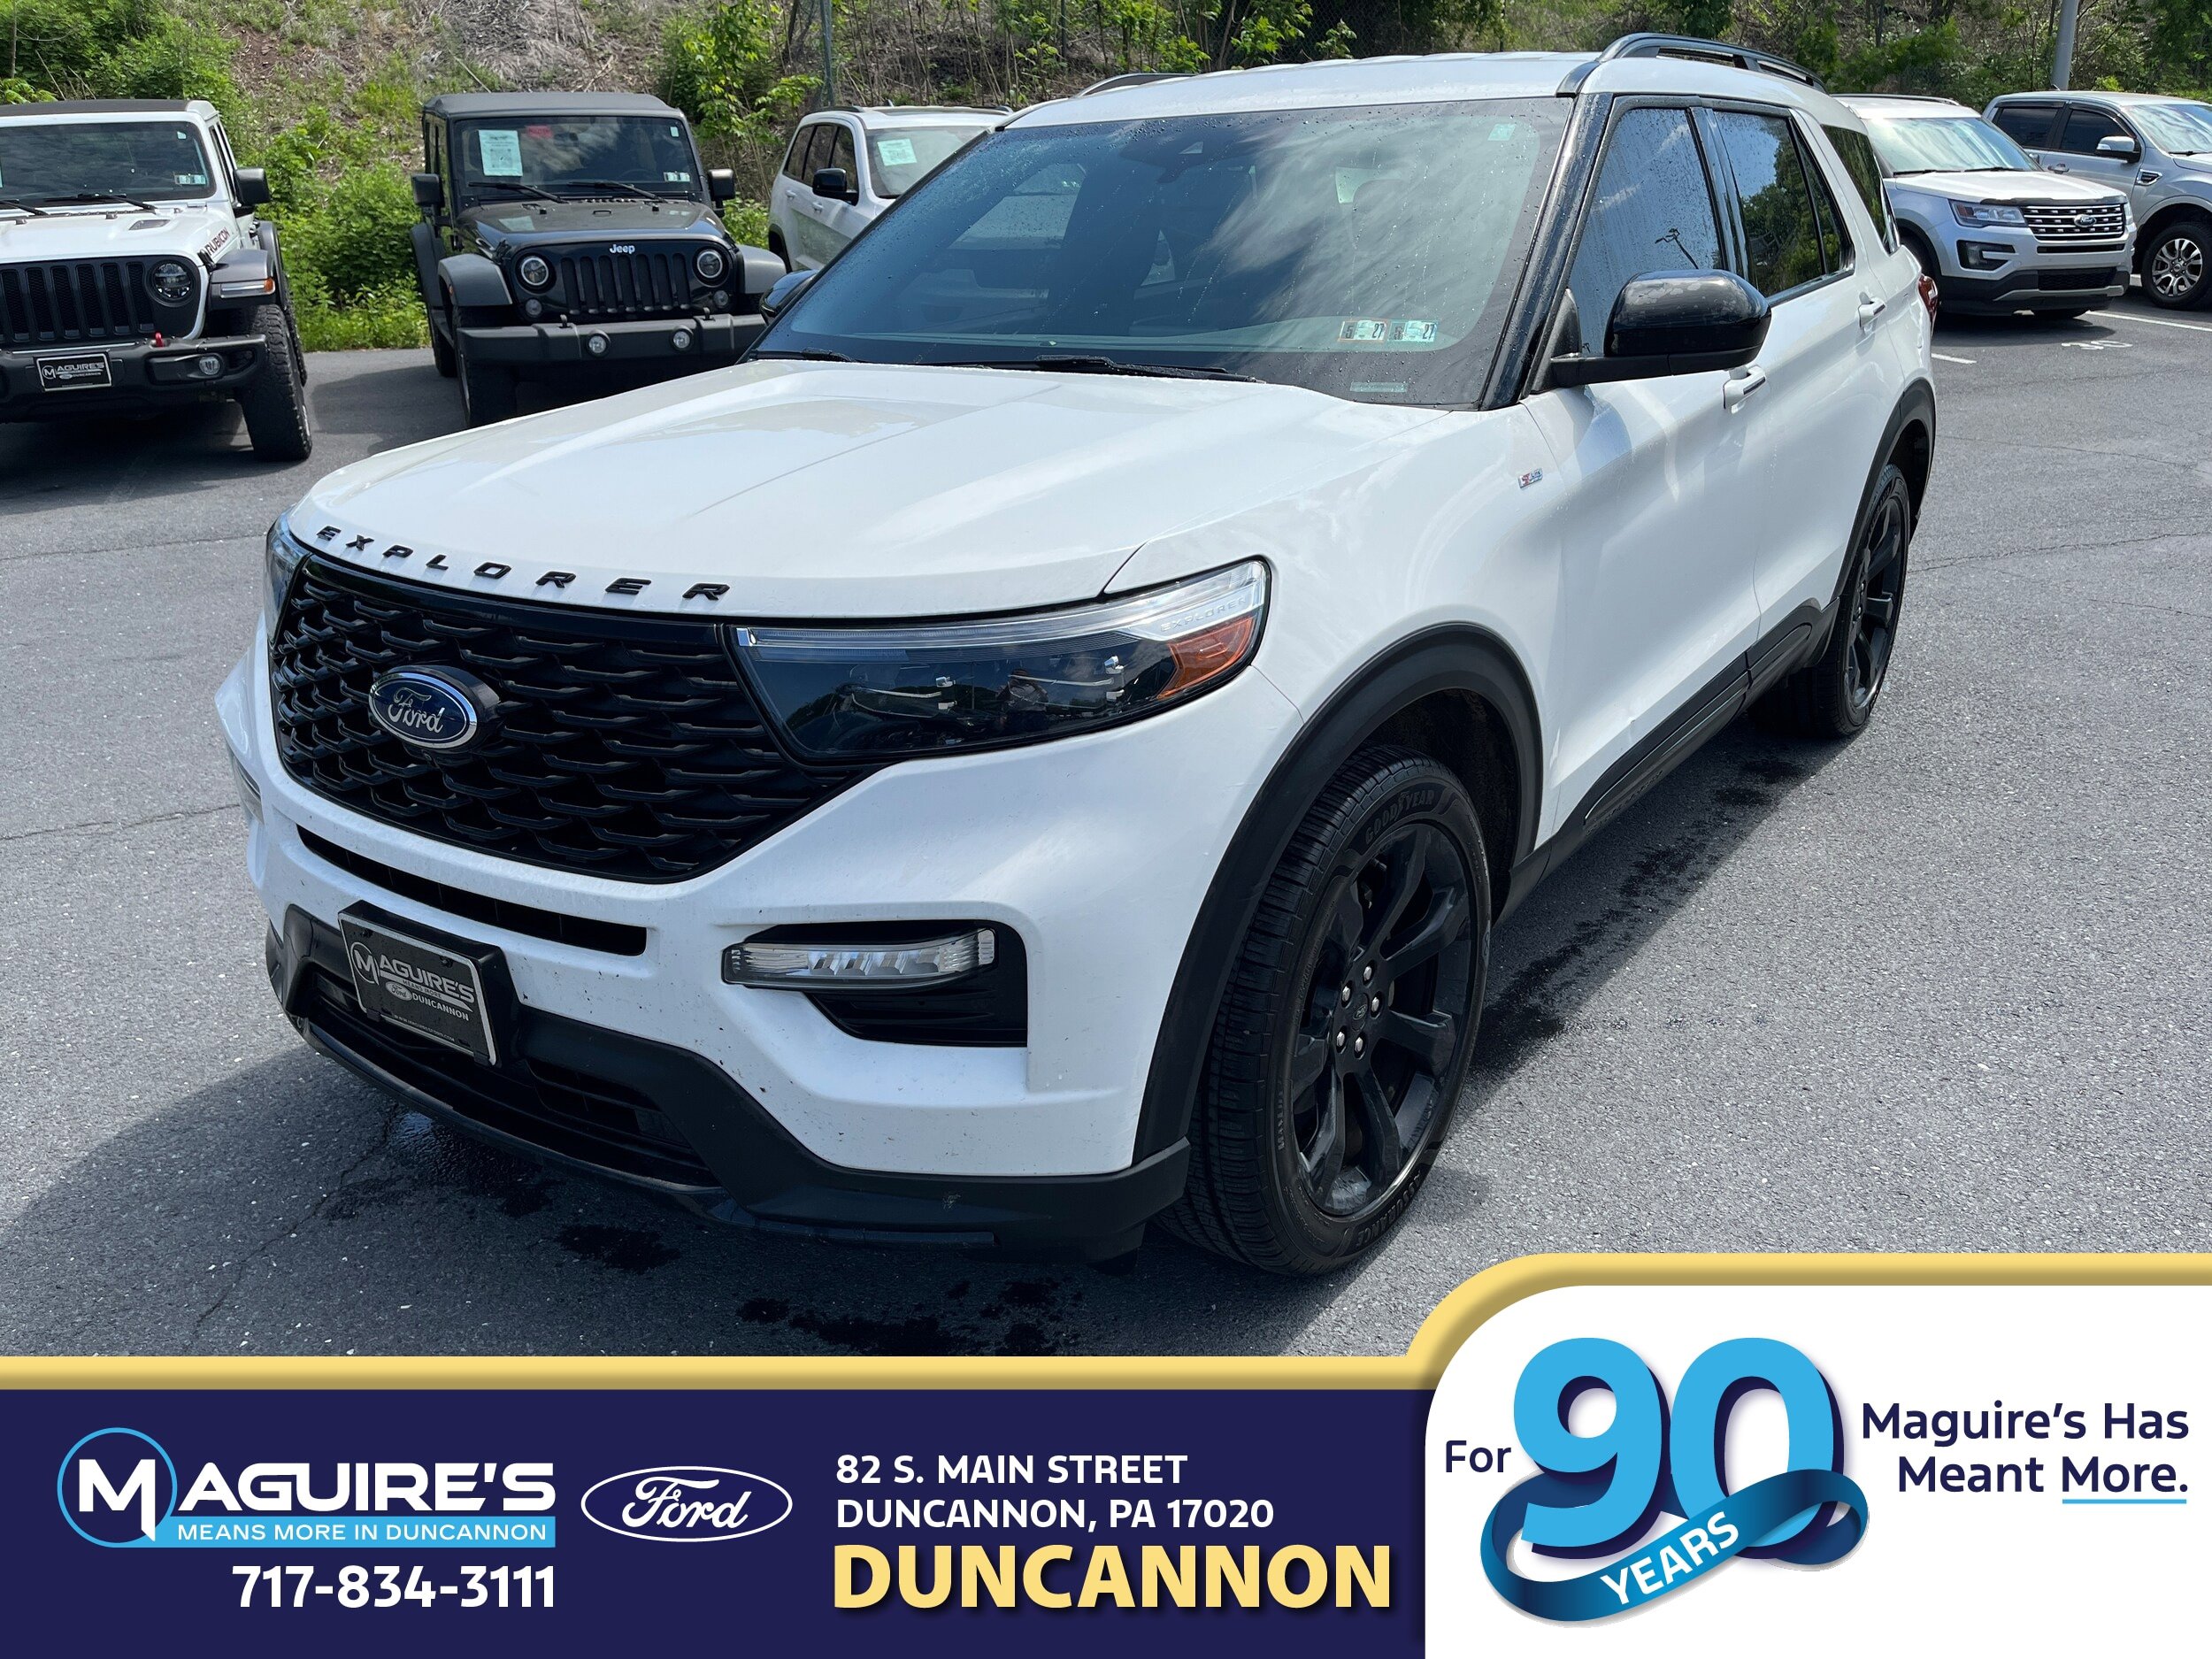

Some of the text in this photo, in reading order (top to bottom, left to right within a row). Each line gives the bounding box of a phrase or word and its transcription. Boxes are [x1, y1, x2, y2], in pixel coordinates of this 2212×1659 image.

[204, 227, 231, 256] RUBICON
[609, 243, 636, 255] Jeep
[1371, 322, 1386, 340] 27
[1422, 323, 1436, 341] 27
[316, 524, 732, 602] EXPLORER
[1160, 595, 1247, 632] EXPLORER
[388, 687, 446, 733] Ford
[1364, 788, 1435, 845] GOODYEAR
[353, 949, 476, 1004] MAGUIRE'S
[390, 982, 408, 998] Ford
[402, 979, 424, 992] MEANS
[411, 993, 470, 1022] DUNCANNON
